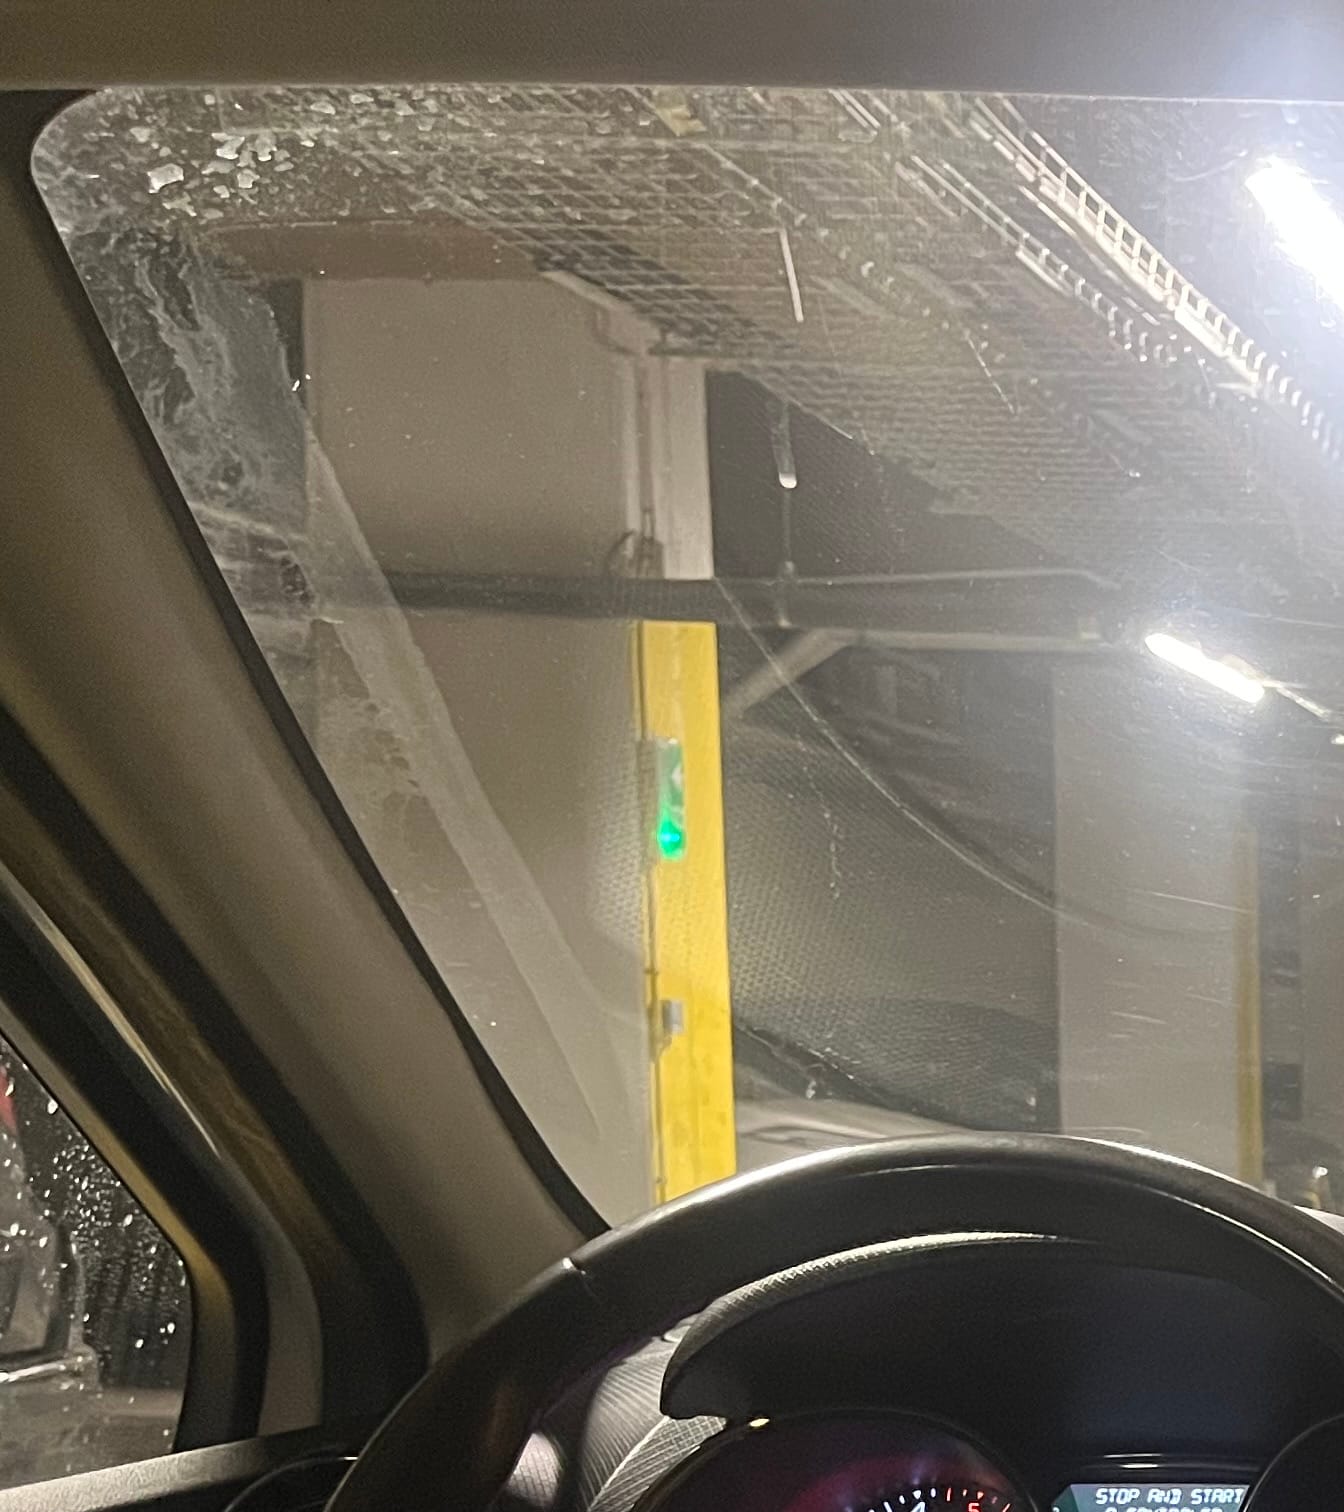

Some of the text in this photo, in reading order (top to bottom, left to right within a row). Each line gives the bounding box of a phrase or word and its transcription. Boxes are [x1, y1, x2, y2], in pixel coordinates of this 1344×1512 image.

[1095, 1488, 1245, 1505] STOP AND START
